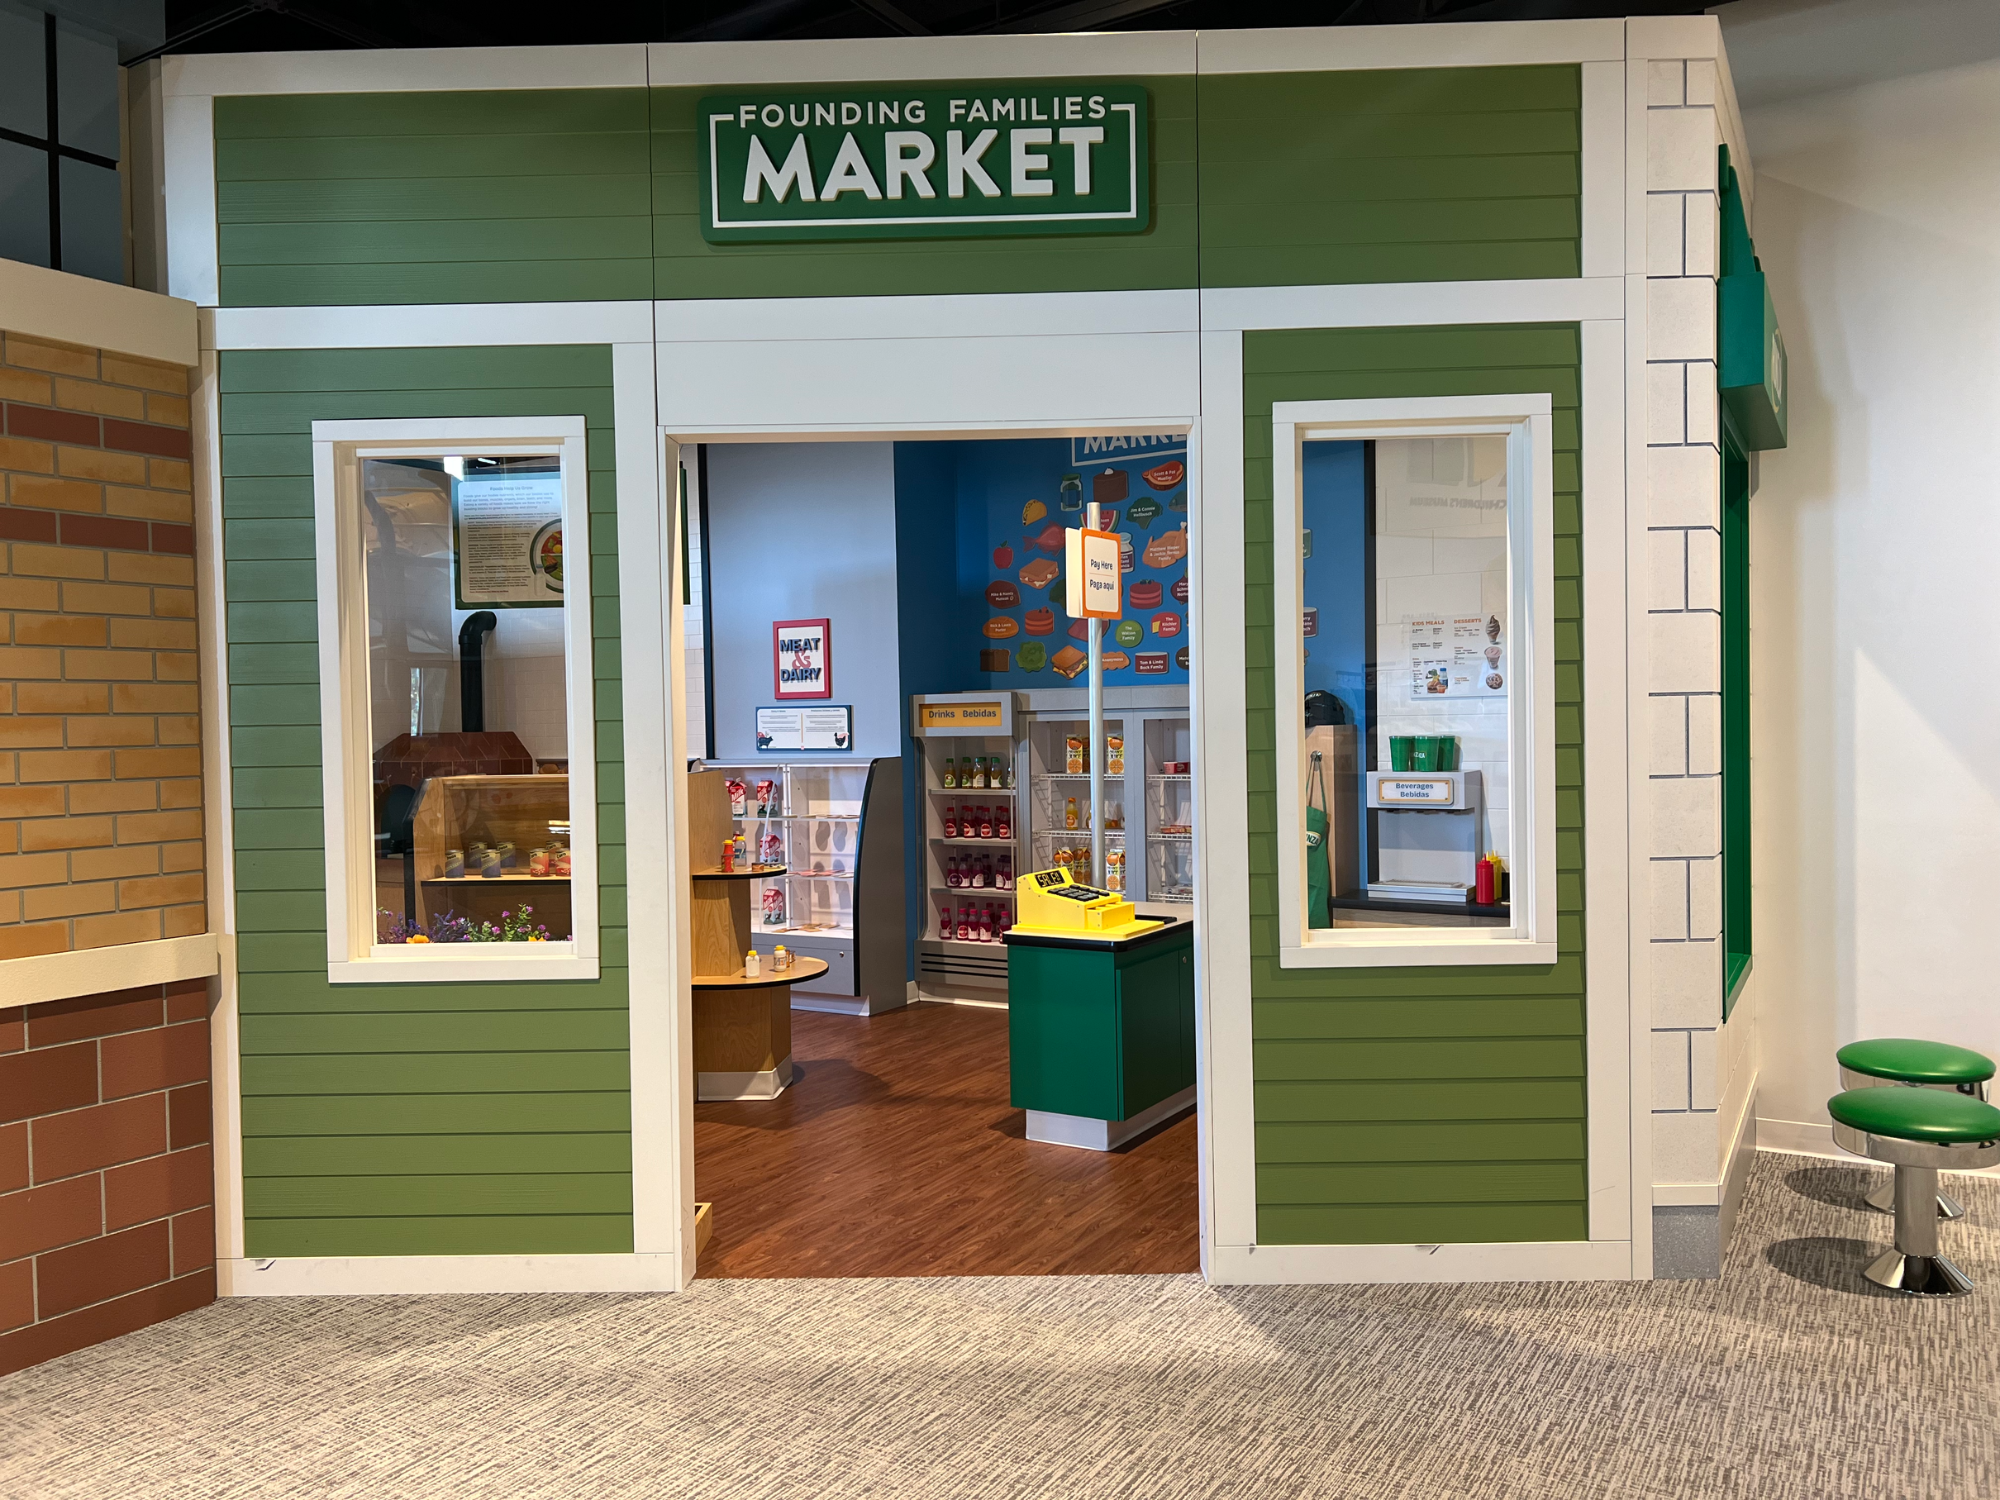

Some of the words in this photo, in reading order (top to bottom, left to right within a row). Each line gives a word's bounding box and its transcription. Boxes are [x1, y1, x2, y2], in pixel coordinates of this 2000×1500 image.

[739, 99, 926, 128] FOUNDING
[949, 96, 1107, 122] FAMILIES
[742, 126, 1105, 203] MARKET
[1090, 558, 1100, 570] Pay
[1101, 560, 1113, 570] Here
[1090, 579, 1102, 590] Paga
[780, 637, 821, 653] MEAT
[792, 649, 812, 670] &
[780, 667, 822, 683] DAIRY
[928, 710, 955, 719] Drinks
[962, 708, 997, 718] Bebidas
[731, 788, 745, 802] Milk
